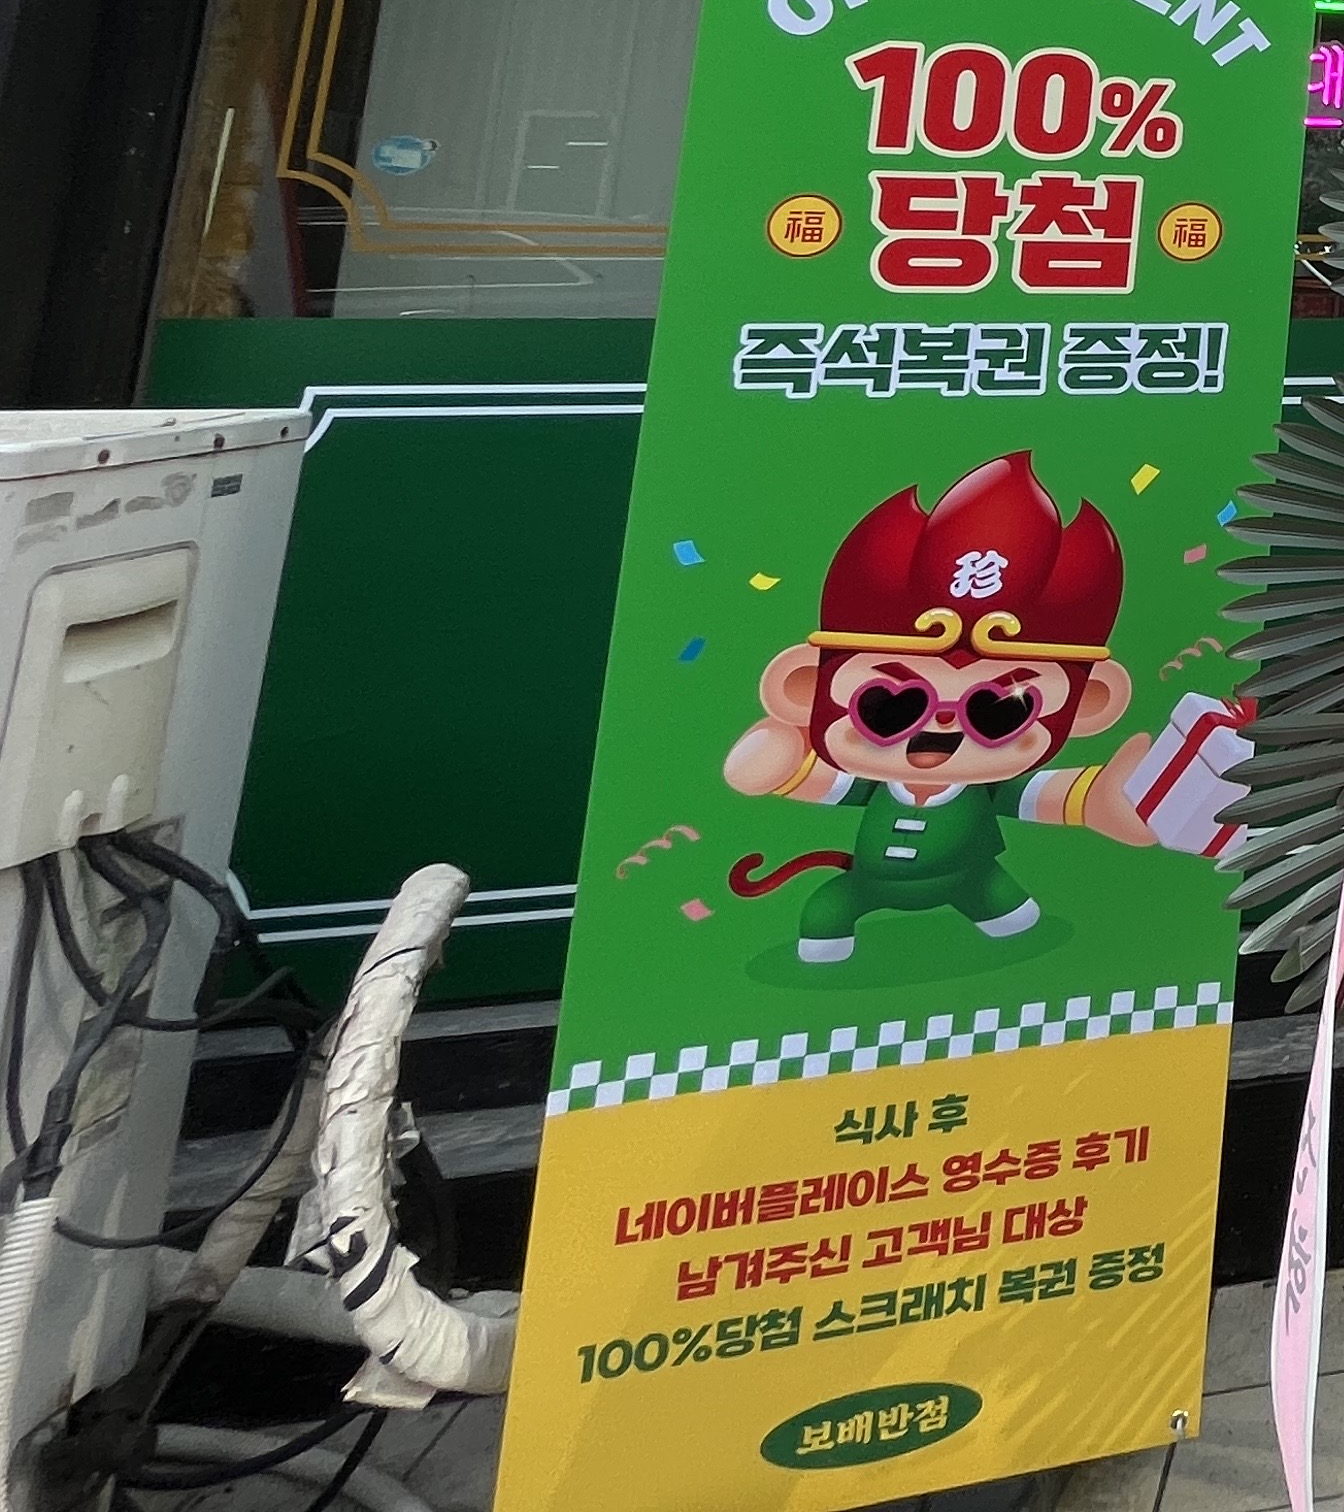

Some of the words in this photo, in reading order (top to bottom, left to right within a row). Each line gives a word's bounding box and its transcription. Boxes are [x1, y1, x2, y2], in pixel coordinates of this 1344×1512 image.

[846, 41, 1183, 159] 100%
[784, 210, 827, 245] 福
[870, 171, 1144, 294] 당첨
[1171, 218, 1207, 250] 福
[734, 322, 1052, 398] 즉석복권
[1059, 322, 1229, 394] 증정!
[833, 1106, 917, 1145] 식사
[928, 1094, 969, 1137] 후
[614, 1164, 931, 1248] 네이버플레이스
[942, 1141, 1062, 1197] 영수증
[1072, 1125, 1152, 1174] 후기
[676, 1234, 853, 1301] 남겨주신
[861, 1212, 994, 1269] 고객님
[1002, 1194, 1088, 1246] 대상
[576, 1307, 802, 1384] 100%당첨
[813, 1273, 988, 1341] 스크래치
[998, 1256, 1079, 1305] 복권
[1087, 1241, 1167, 1292] 증정
[794, 1395, 951, 1457] 보배반점
